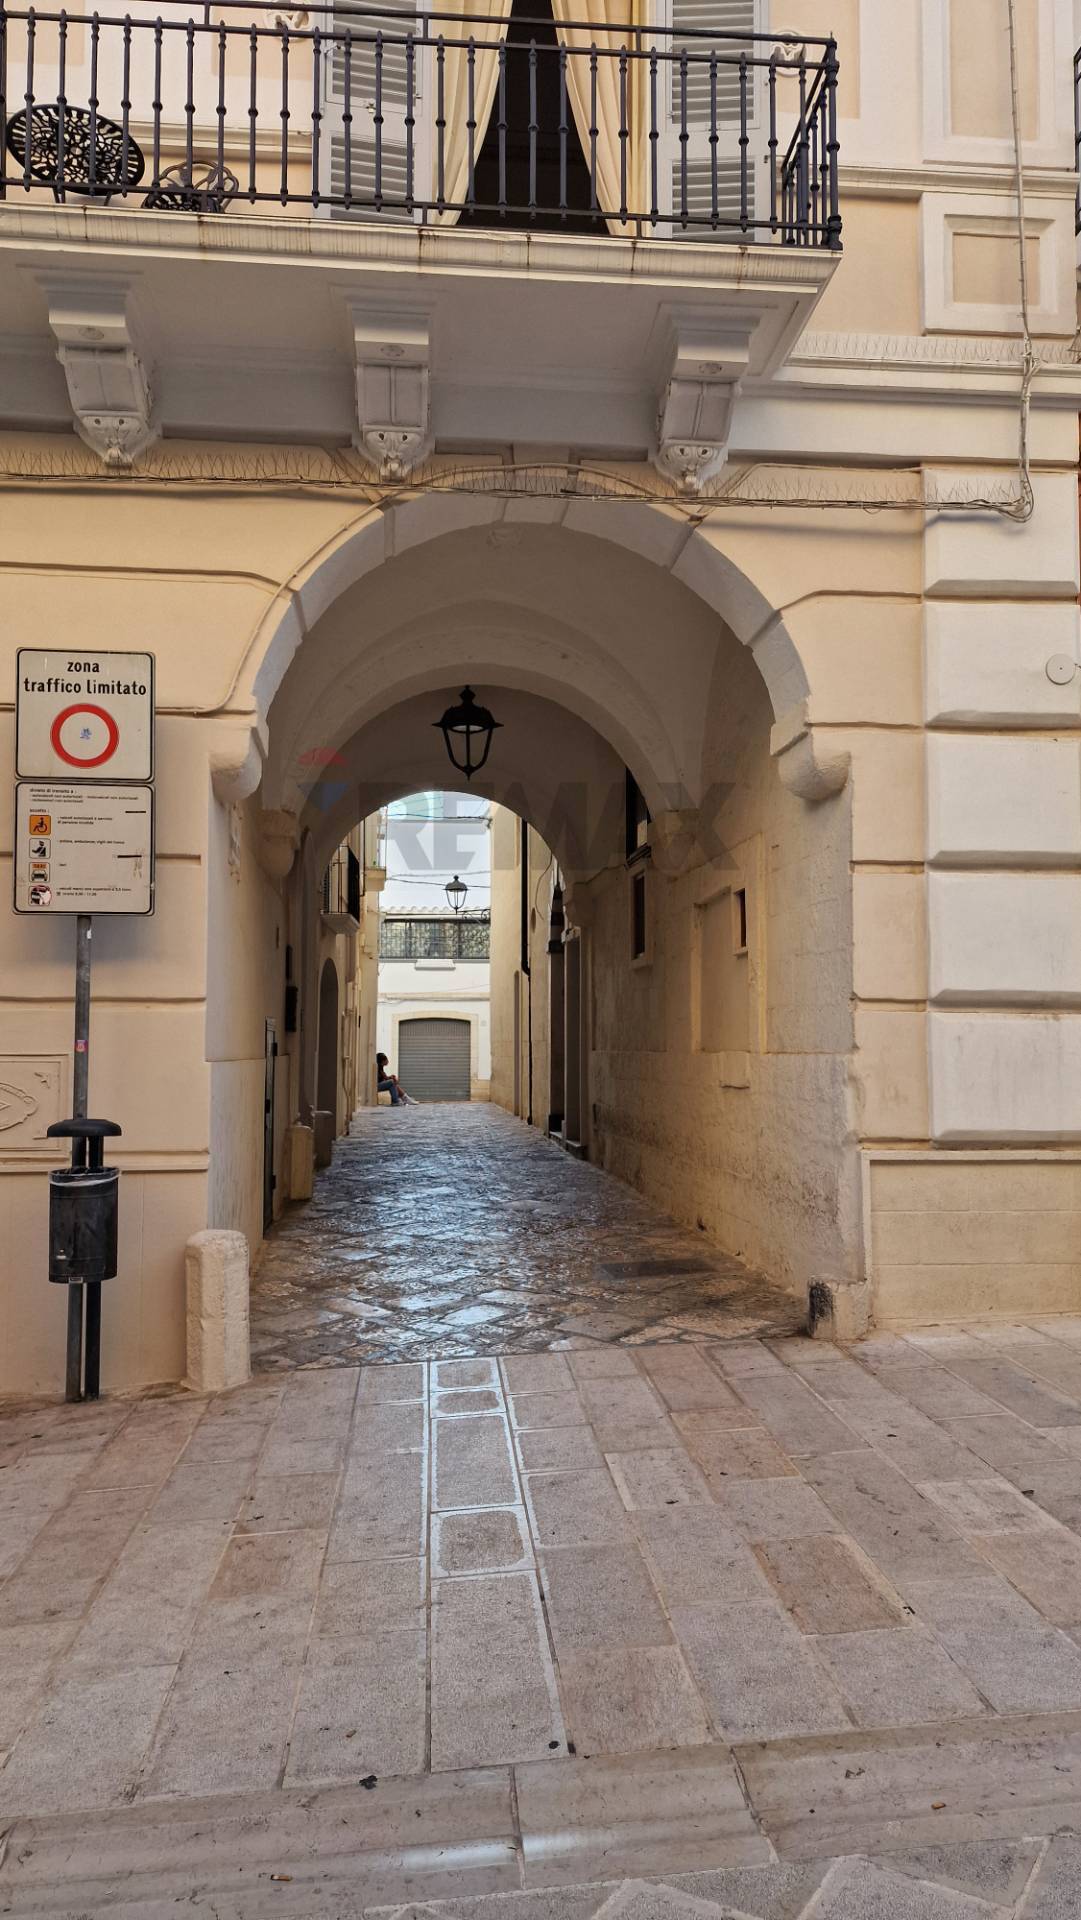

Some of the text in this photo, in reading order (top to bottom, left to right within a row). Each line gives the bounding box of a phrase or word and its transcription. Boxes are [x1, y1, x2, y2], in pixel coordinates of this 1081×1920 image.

[67, 661, 100, 673] zona
[24, 678, 147, 695] traffico limitato
